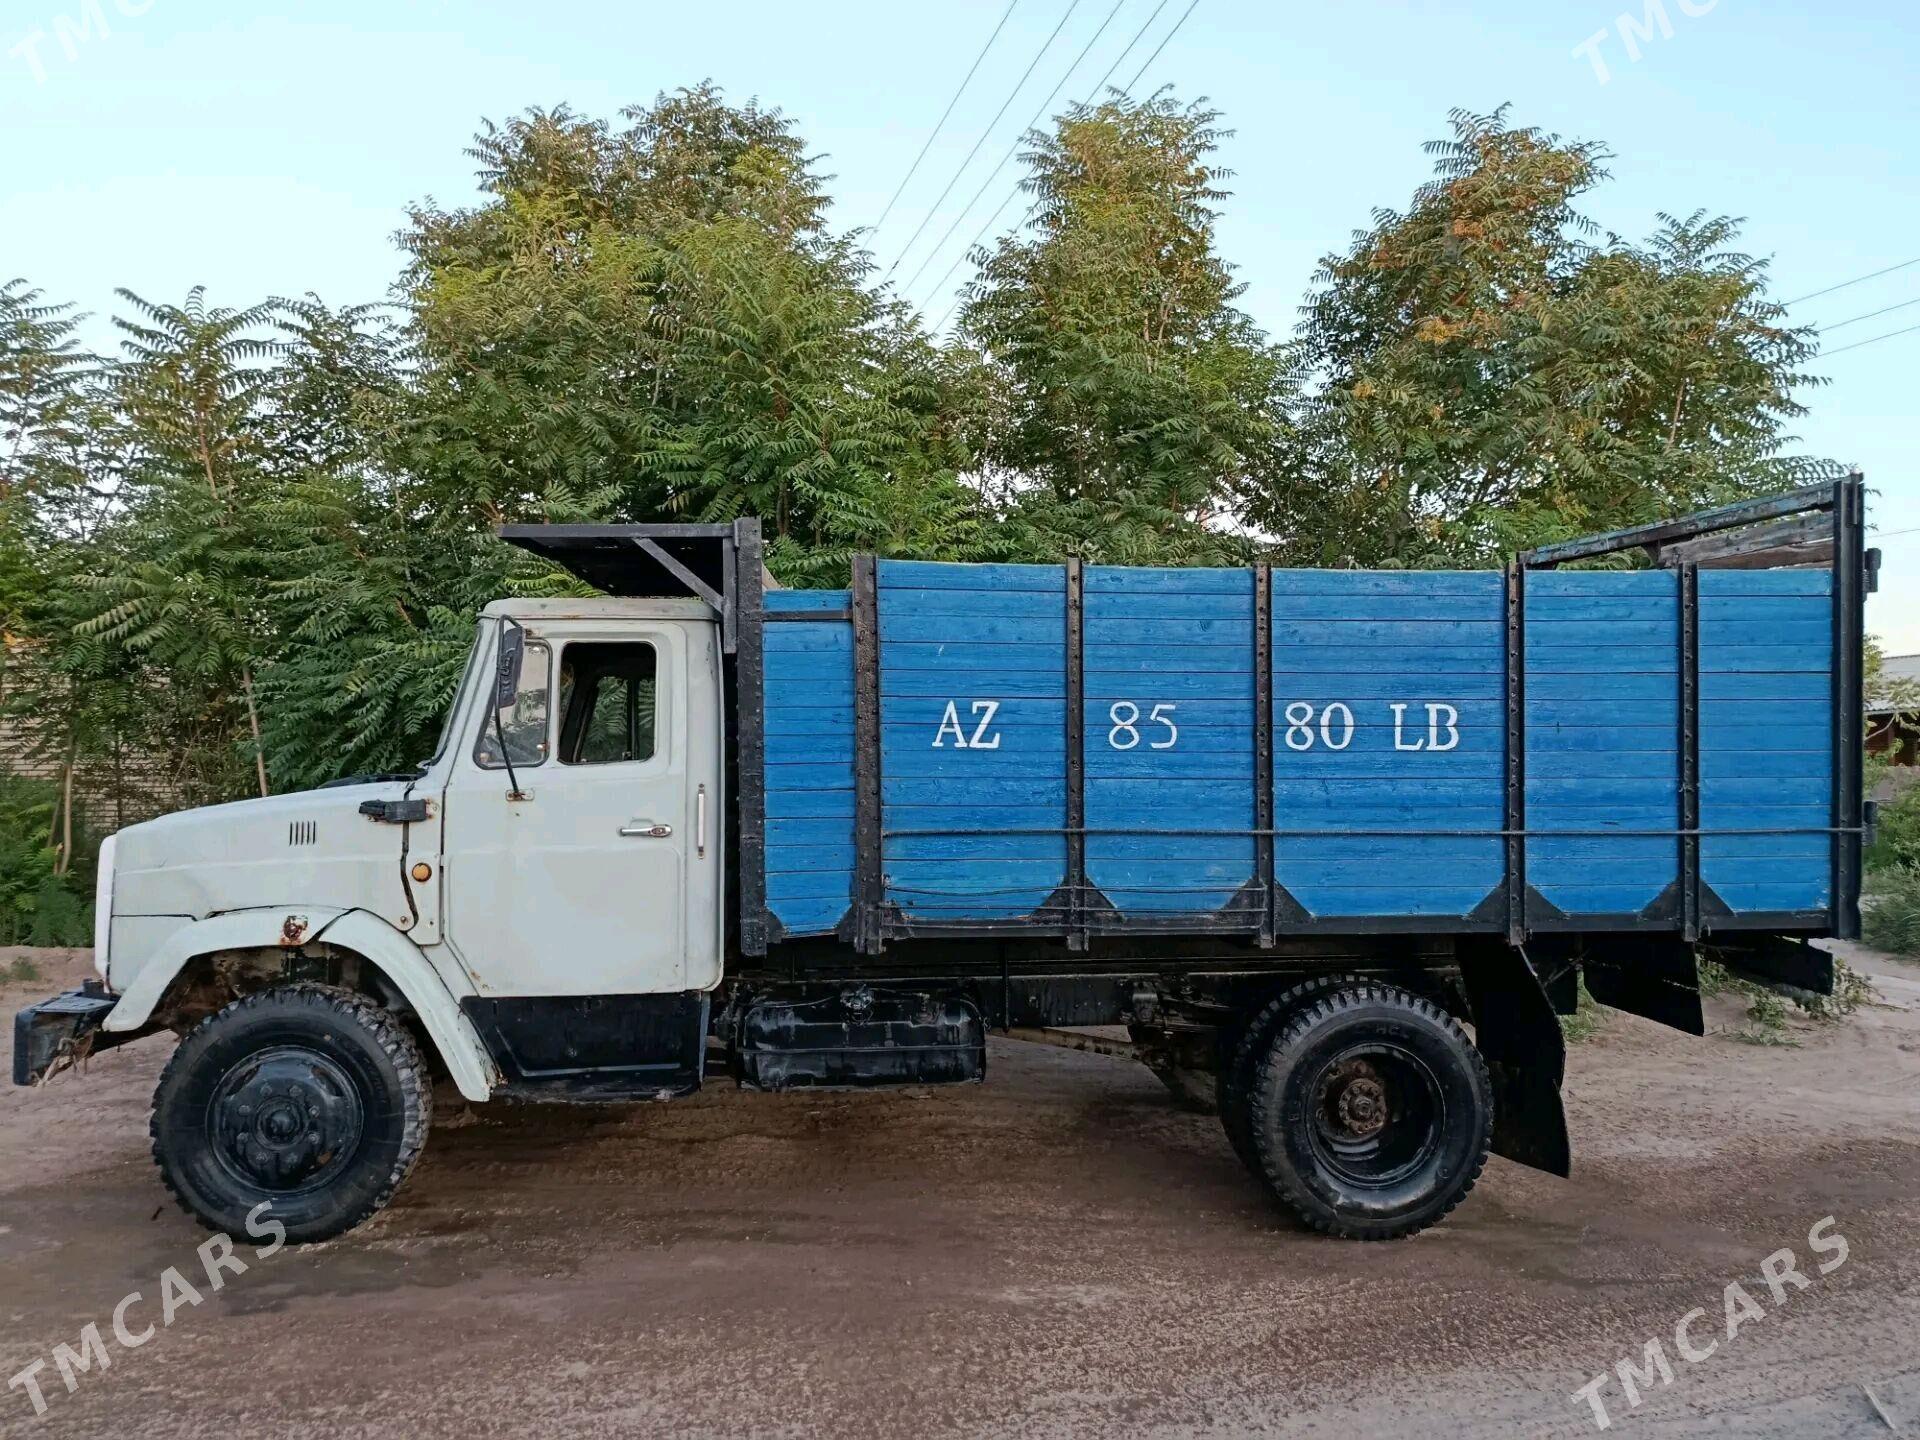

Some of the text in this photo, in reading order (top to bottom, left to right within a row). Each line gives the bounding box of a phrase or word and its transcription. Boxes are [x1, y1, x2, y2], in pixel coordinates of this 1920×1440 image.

[931, 700, 1459, 751] AZ 85 80 LB
